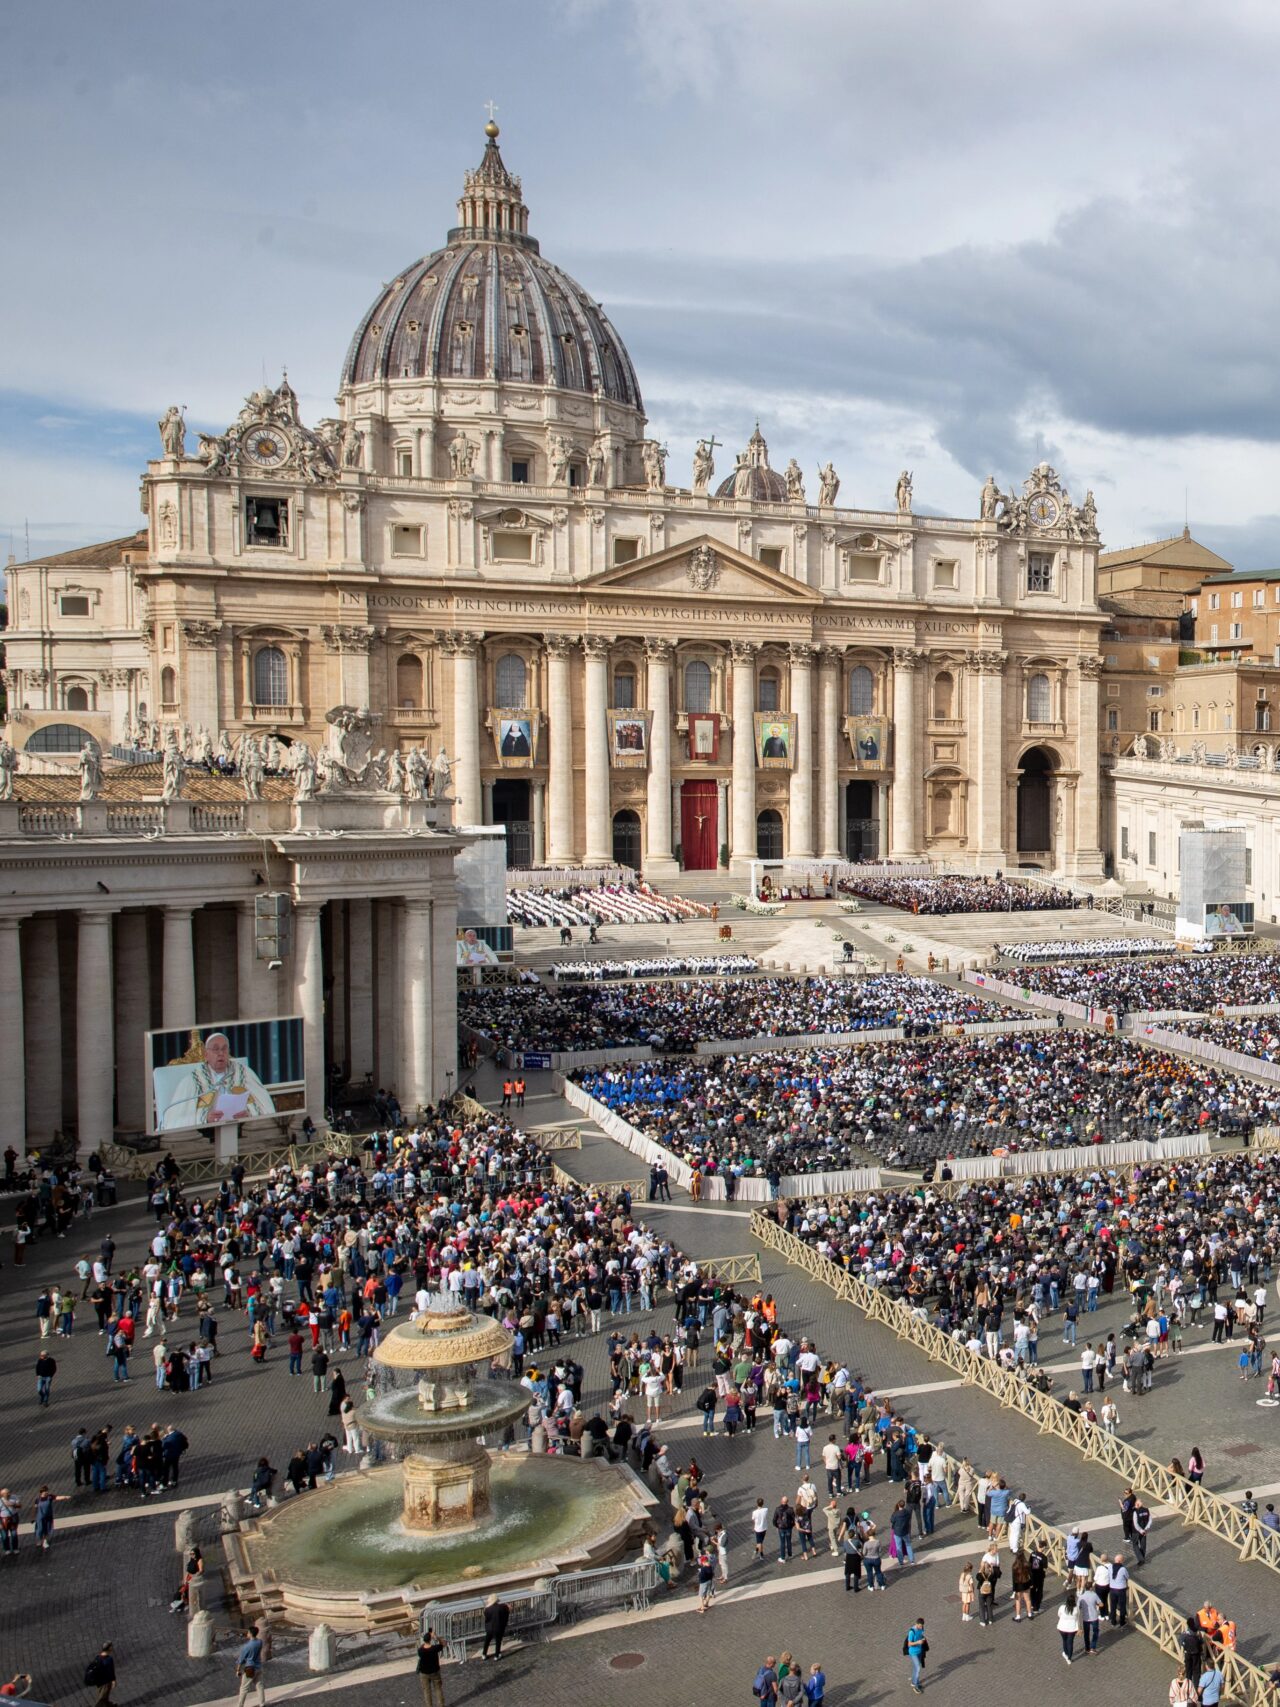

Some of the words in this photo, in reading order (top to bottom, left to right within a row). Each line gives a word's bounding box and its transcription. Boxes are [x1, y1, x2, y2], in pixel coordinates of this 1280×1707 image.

[341, 593, 360, 605] IN
[367, 594, 449, 609] HONOREM
[455, 599, 535, 613] PRINCIPIS
[538, 602, 583, 615] APOST
[588, 603, 638, 616] PAVLVS
[640, 607, 649, 617] V
[652, 607, 739, 621] BVRGHESIVS
[743, 611, 811, 625] ROMANVS
[945, 623, 976, 634] PONT
[984, 623, 1001, 634] VII
